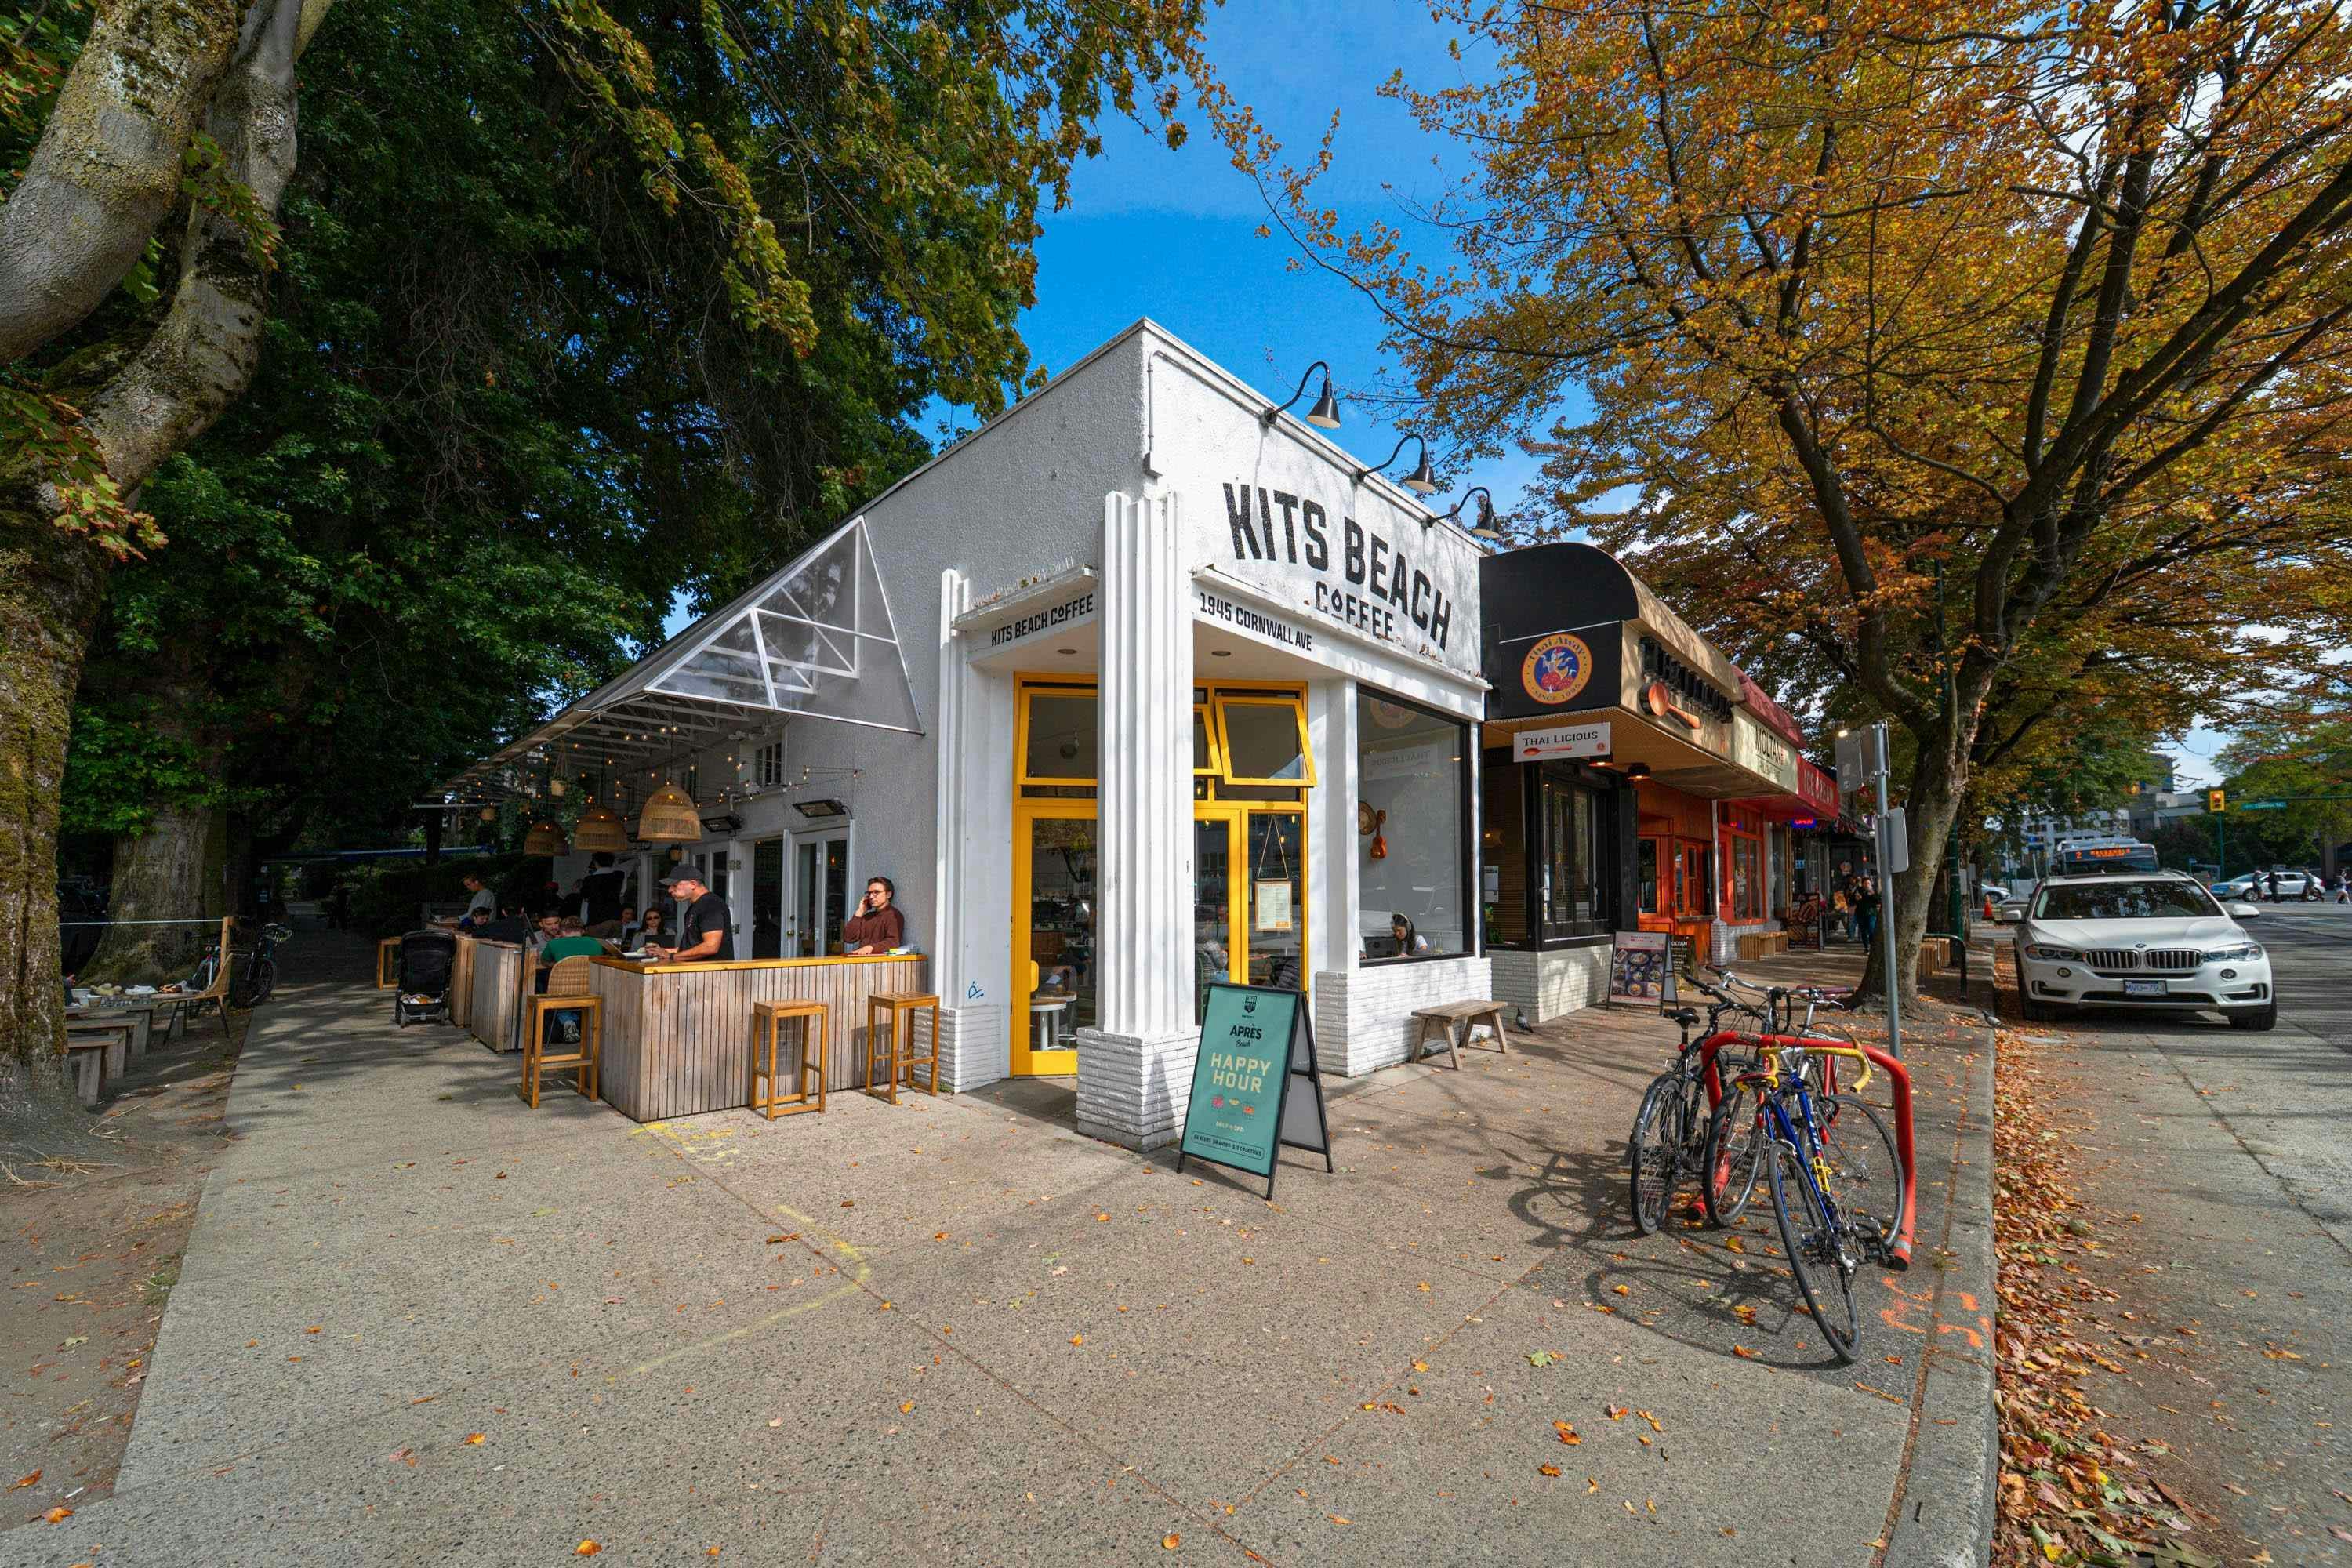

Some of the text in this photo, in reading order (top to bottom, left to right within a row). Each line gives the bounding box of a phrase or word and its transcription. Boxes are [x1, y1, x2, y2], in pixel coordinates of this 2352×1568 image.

[1223, 482, 1451, 652] KITS BEACH
[991, 594, 1093, 646] KITS BEACH COFFEE
[1200, 592, 1312, 652] 1945 CORNWALL AVE
[1316, 581, 1394, 642] COFFEE
[1530, 636, 1586, 661] Thai Away
[1523, 731, 1599, 746] THAI LICIOUS
[1755, 722, 1783, 766] MOLTAN
[1229, 1023, 1262, 1040] APRÈS
[1210, 1052, 1272, 1076] HAPPY
[1212, 1070, 1263, 1094] HOUR
